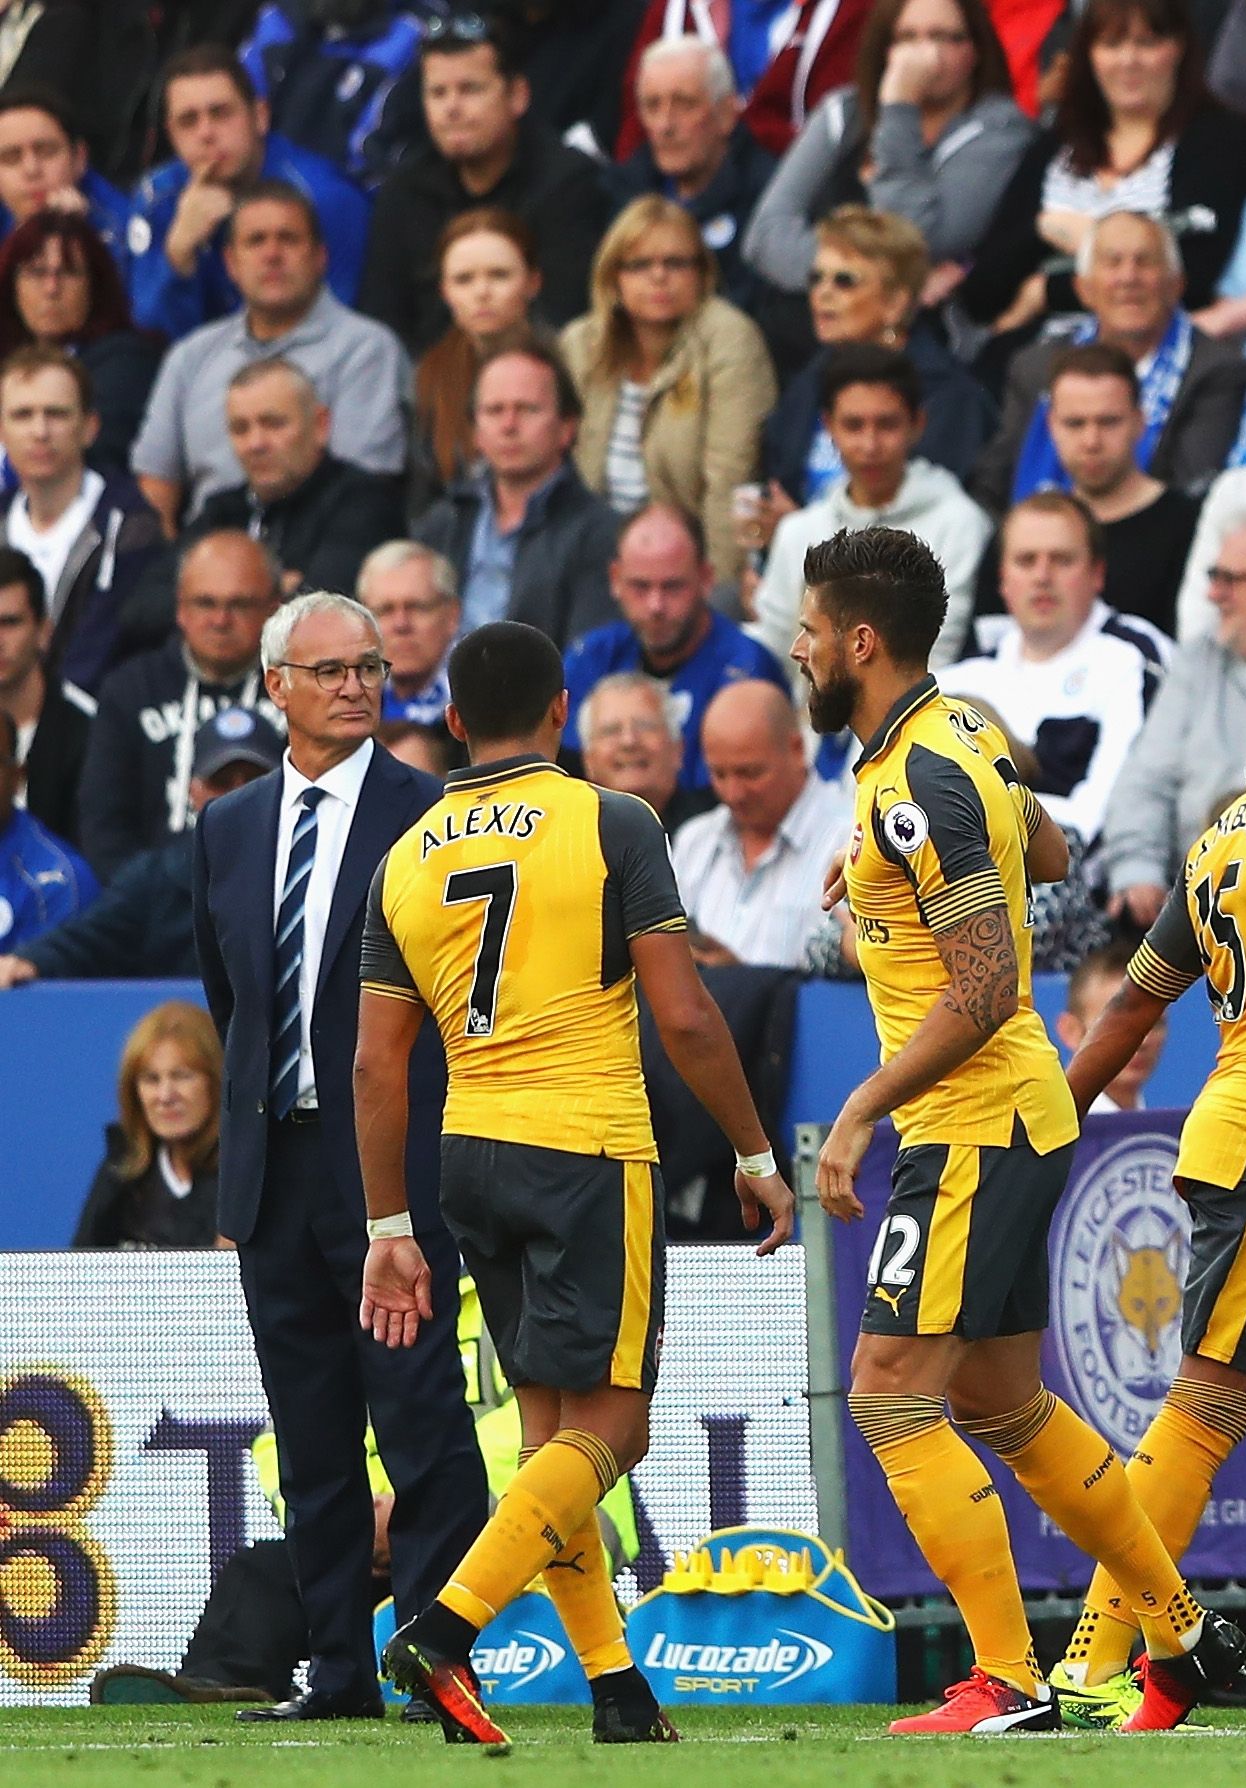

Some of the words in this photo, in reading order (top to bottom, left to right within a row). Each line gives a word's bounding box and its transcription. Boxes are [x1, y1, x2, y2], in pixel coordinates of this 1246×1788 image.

[420, 803, 546, 864] ALEXIS
[442, 860, 519, 1037] 7
[867, 1214, 921, 1286] 12
[1073, 1162, 1173, 1293] LEICESTE
[1074, 1321, 1152, 1437] FOOTB
[1141, 1590, 1158, 1607] 5
[644, 1632, 802, 1674] Lucozade
[673, 1675, 761, 1694] SPORT
